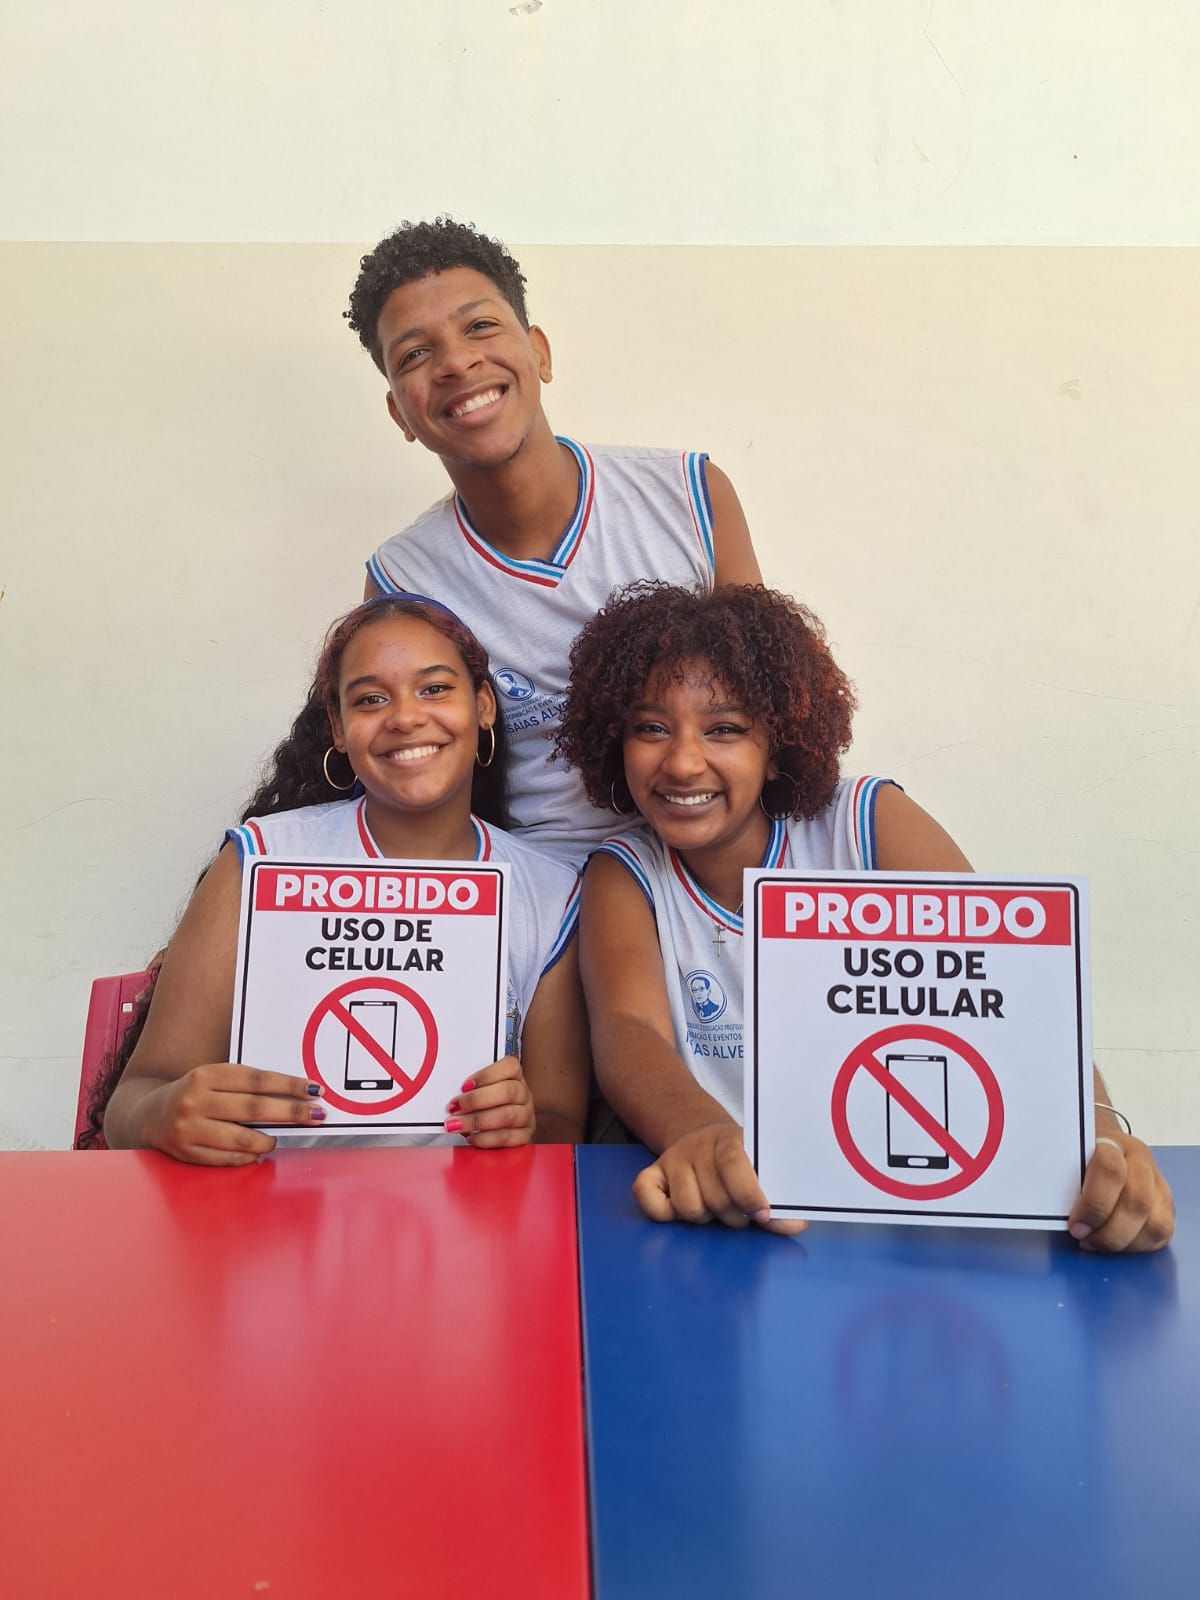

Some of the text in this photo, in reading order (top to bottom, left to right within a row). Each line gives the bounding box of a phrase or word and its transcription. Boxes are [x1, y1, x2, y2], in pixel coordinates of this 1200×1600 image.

[505, 715, 540, 734] SAÍAS
[541, 700, 569, 722] ALVE
[275, 873, 479, 911] PROIBIDO
[321, 917, 432, 942] USO DE
[784, 891, 1046, 939] PROIBIDO
[305, 946, 444, 972] CELULAR
[843, 947, 987, 980] USO DE
[826, 984, 1005, 1018] CELULAR
[713, 1032, 743, 1042] EVENTOS
[713, 1045, 744, 1059] ALVE
